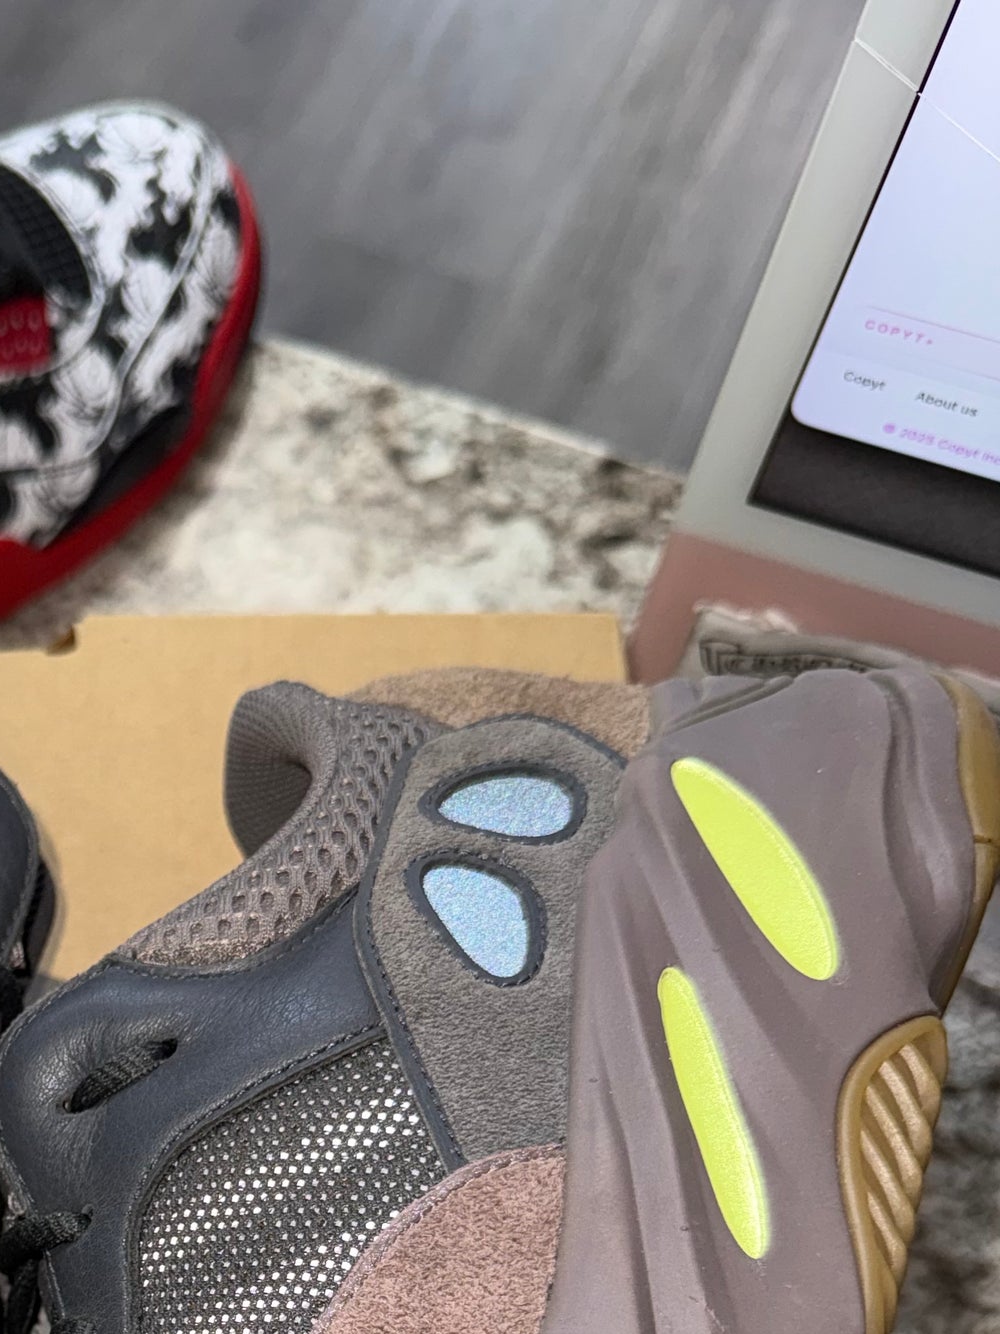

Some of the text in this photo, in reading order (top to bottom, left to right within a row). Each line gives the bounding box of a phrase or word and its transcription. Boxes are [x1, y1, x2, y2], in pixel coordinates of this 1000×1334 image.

[843, 371, 886, 391] Copyt
[914, 391, 979, 417] About us
